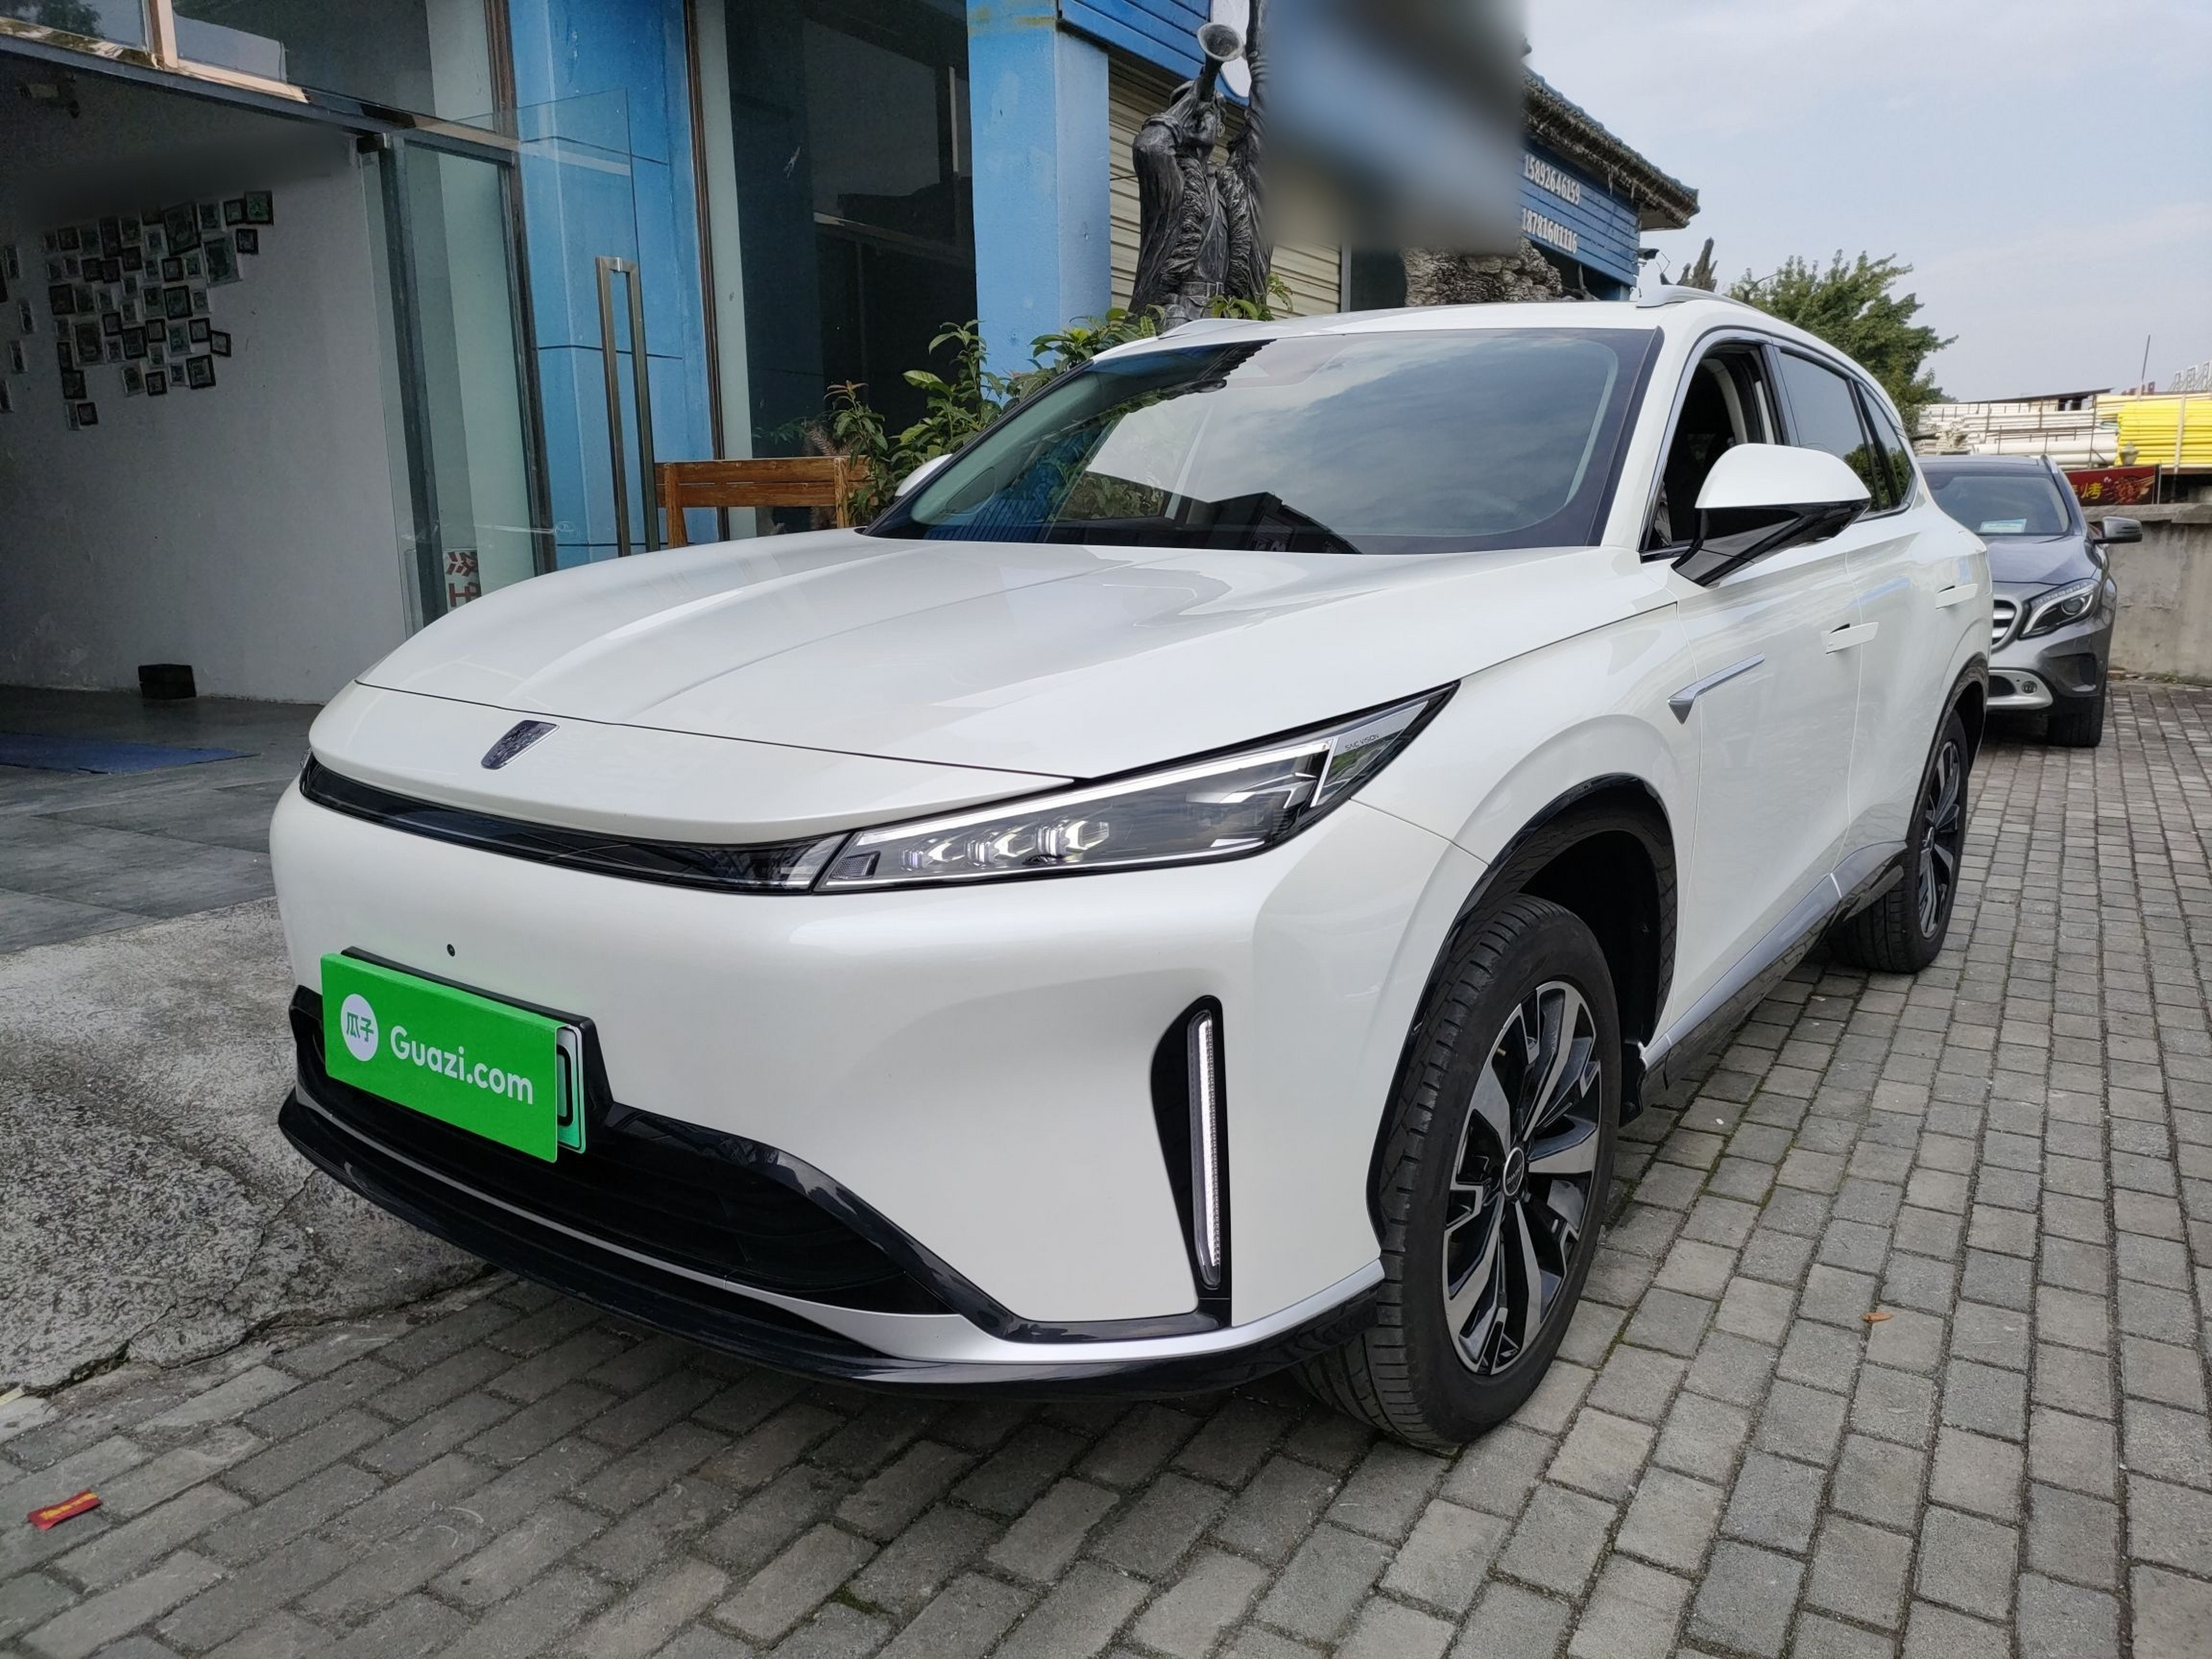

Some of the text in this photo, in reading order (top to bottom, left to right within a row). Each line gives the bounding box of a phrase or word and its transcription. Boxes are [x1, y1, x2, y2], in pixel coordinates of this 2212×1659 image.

[1524, 154, 1580, 205] 15892646159
[1521, 208, 1578, 254] 18781601116
[2072, 482, 2104, 499] 烤
[346, 1012, 374, 1042] 瓜子
[390, 1025, 533, 1105] Guazi.com
